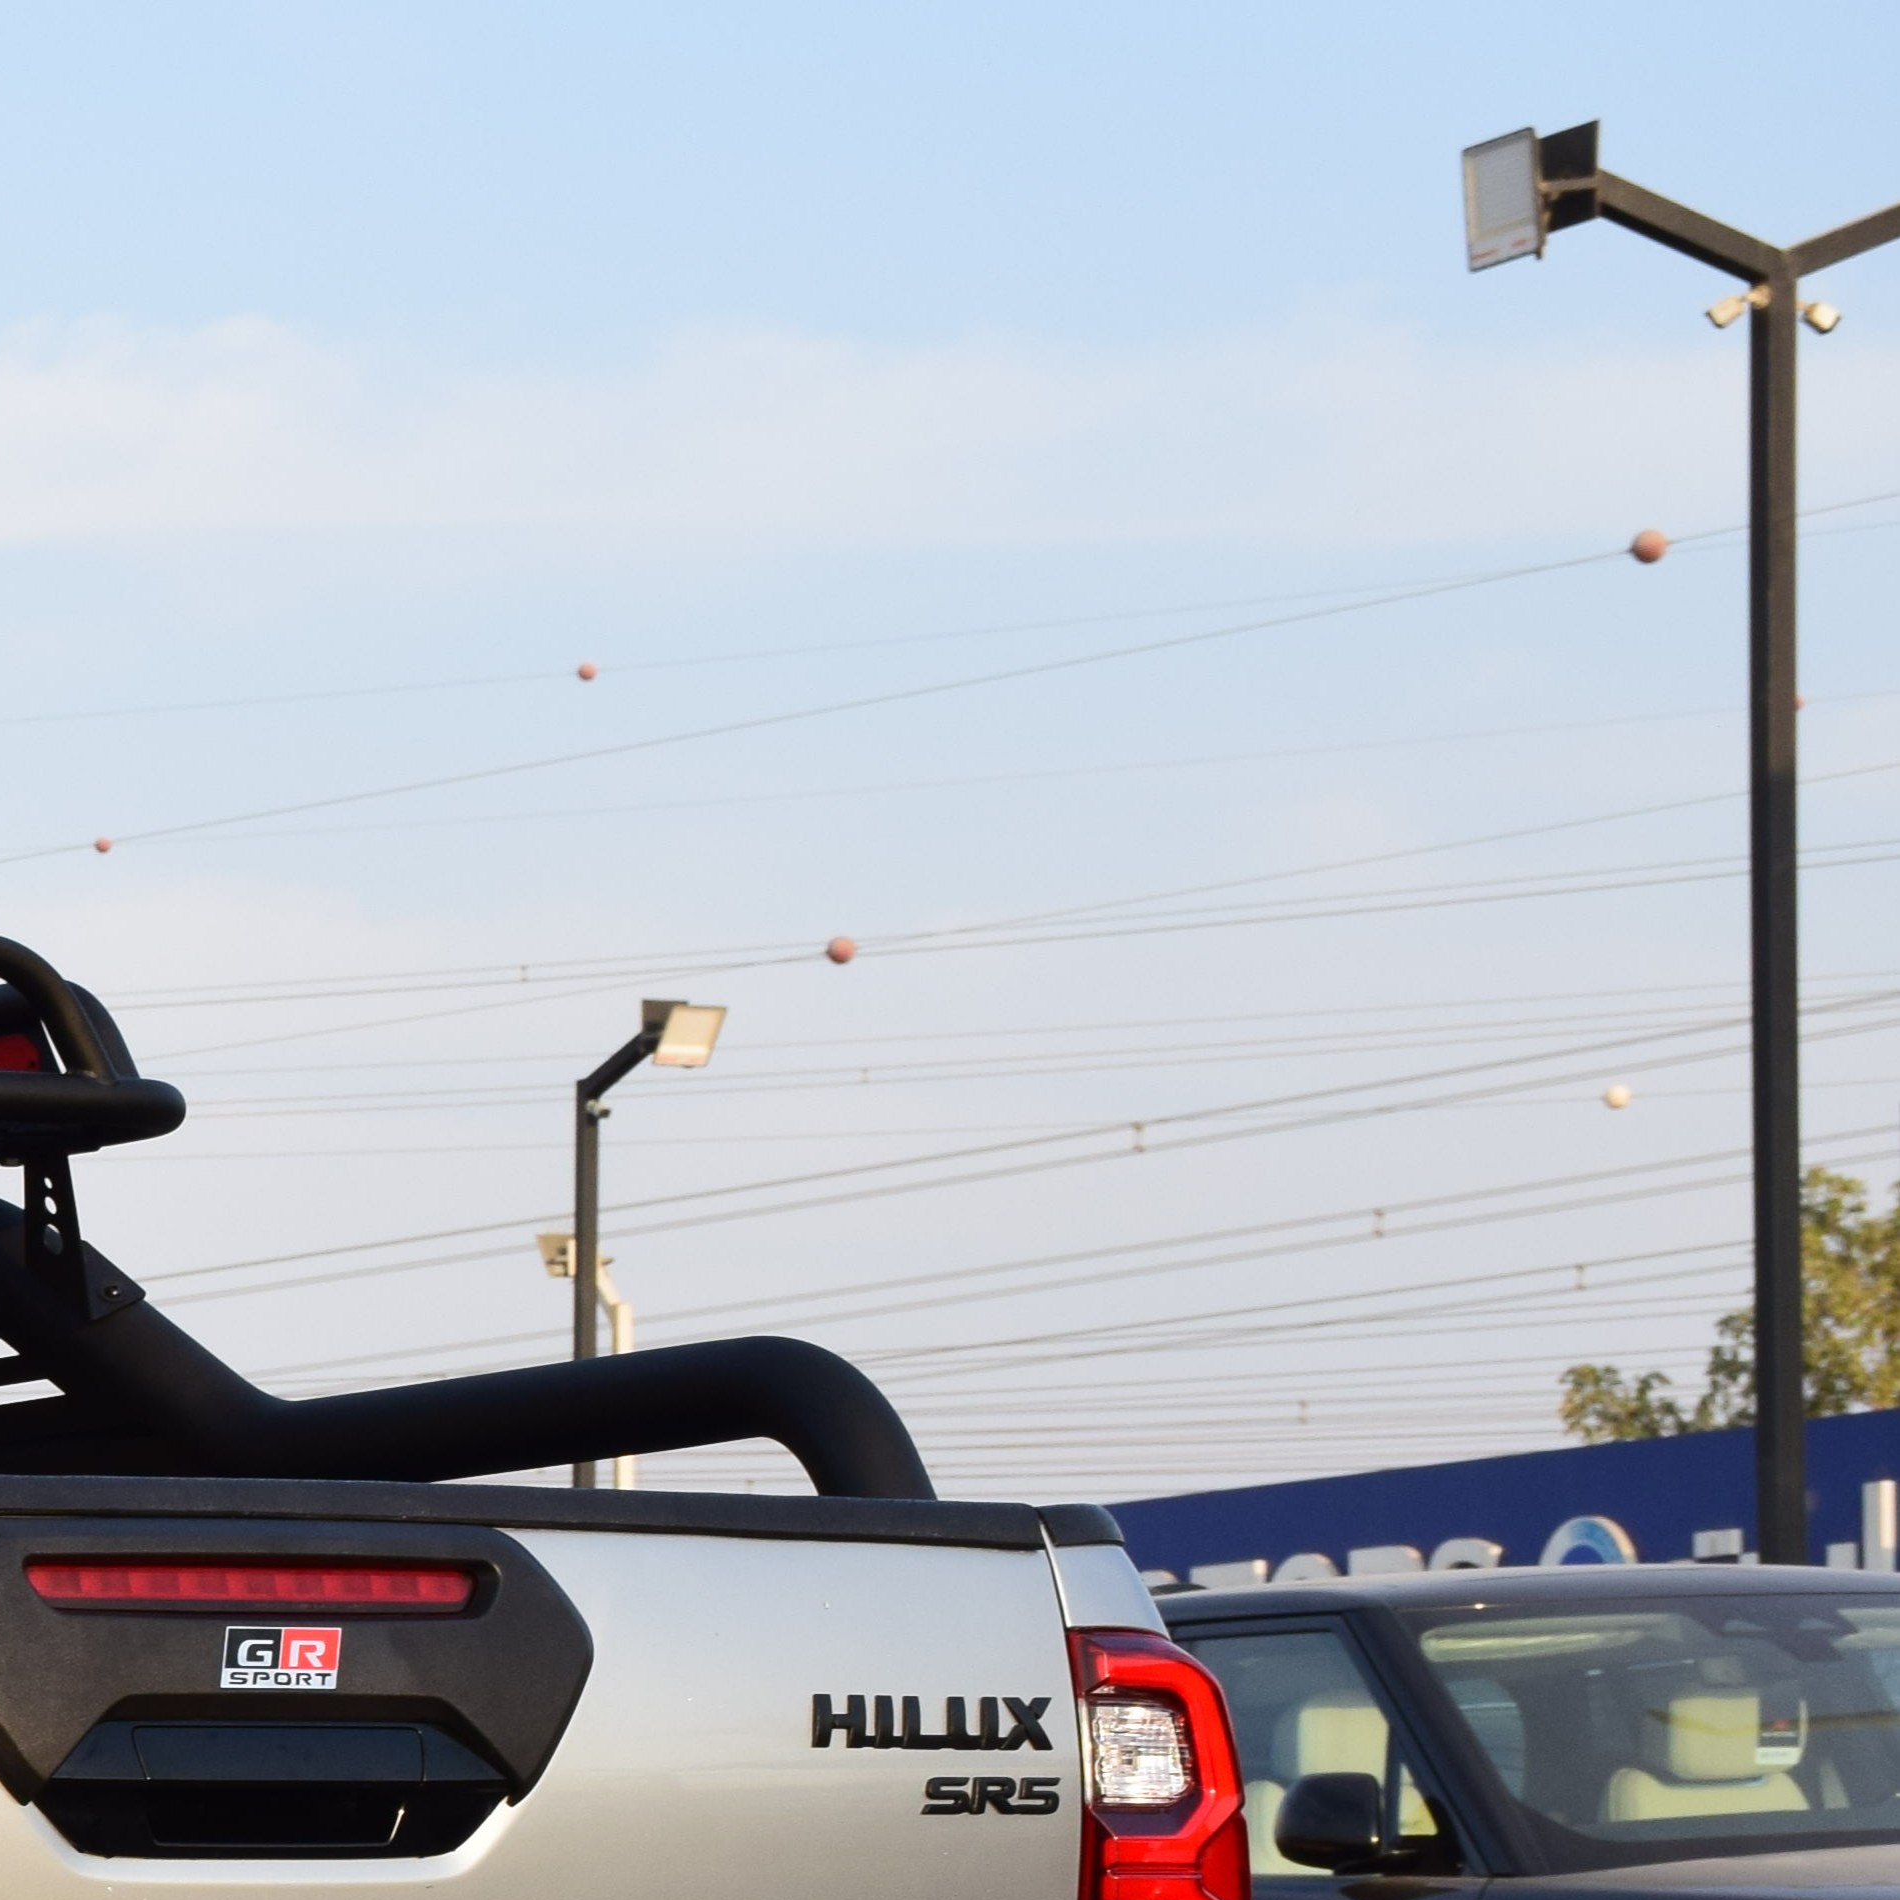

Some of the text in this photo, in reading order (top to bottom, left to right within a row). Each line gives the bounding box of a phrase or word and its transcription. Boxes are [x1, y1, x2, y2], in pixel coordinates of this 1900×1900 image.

[237, 1639, 326, 1668] GR
[228, 1671, 332, 1686] SPORT
[811, 1693, 1053, 1751] HILUX
[920, 1776, 1061, 1815] SR5
